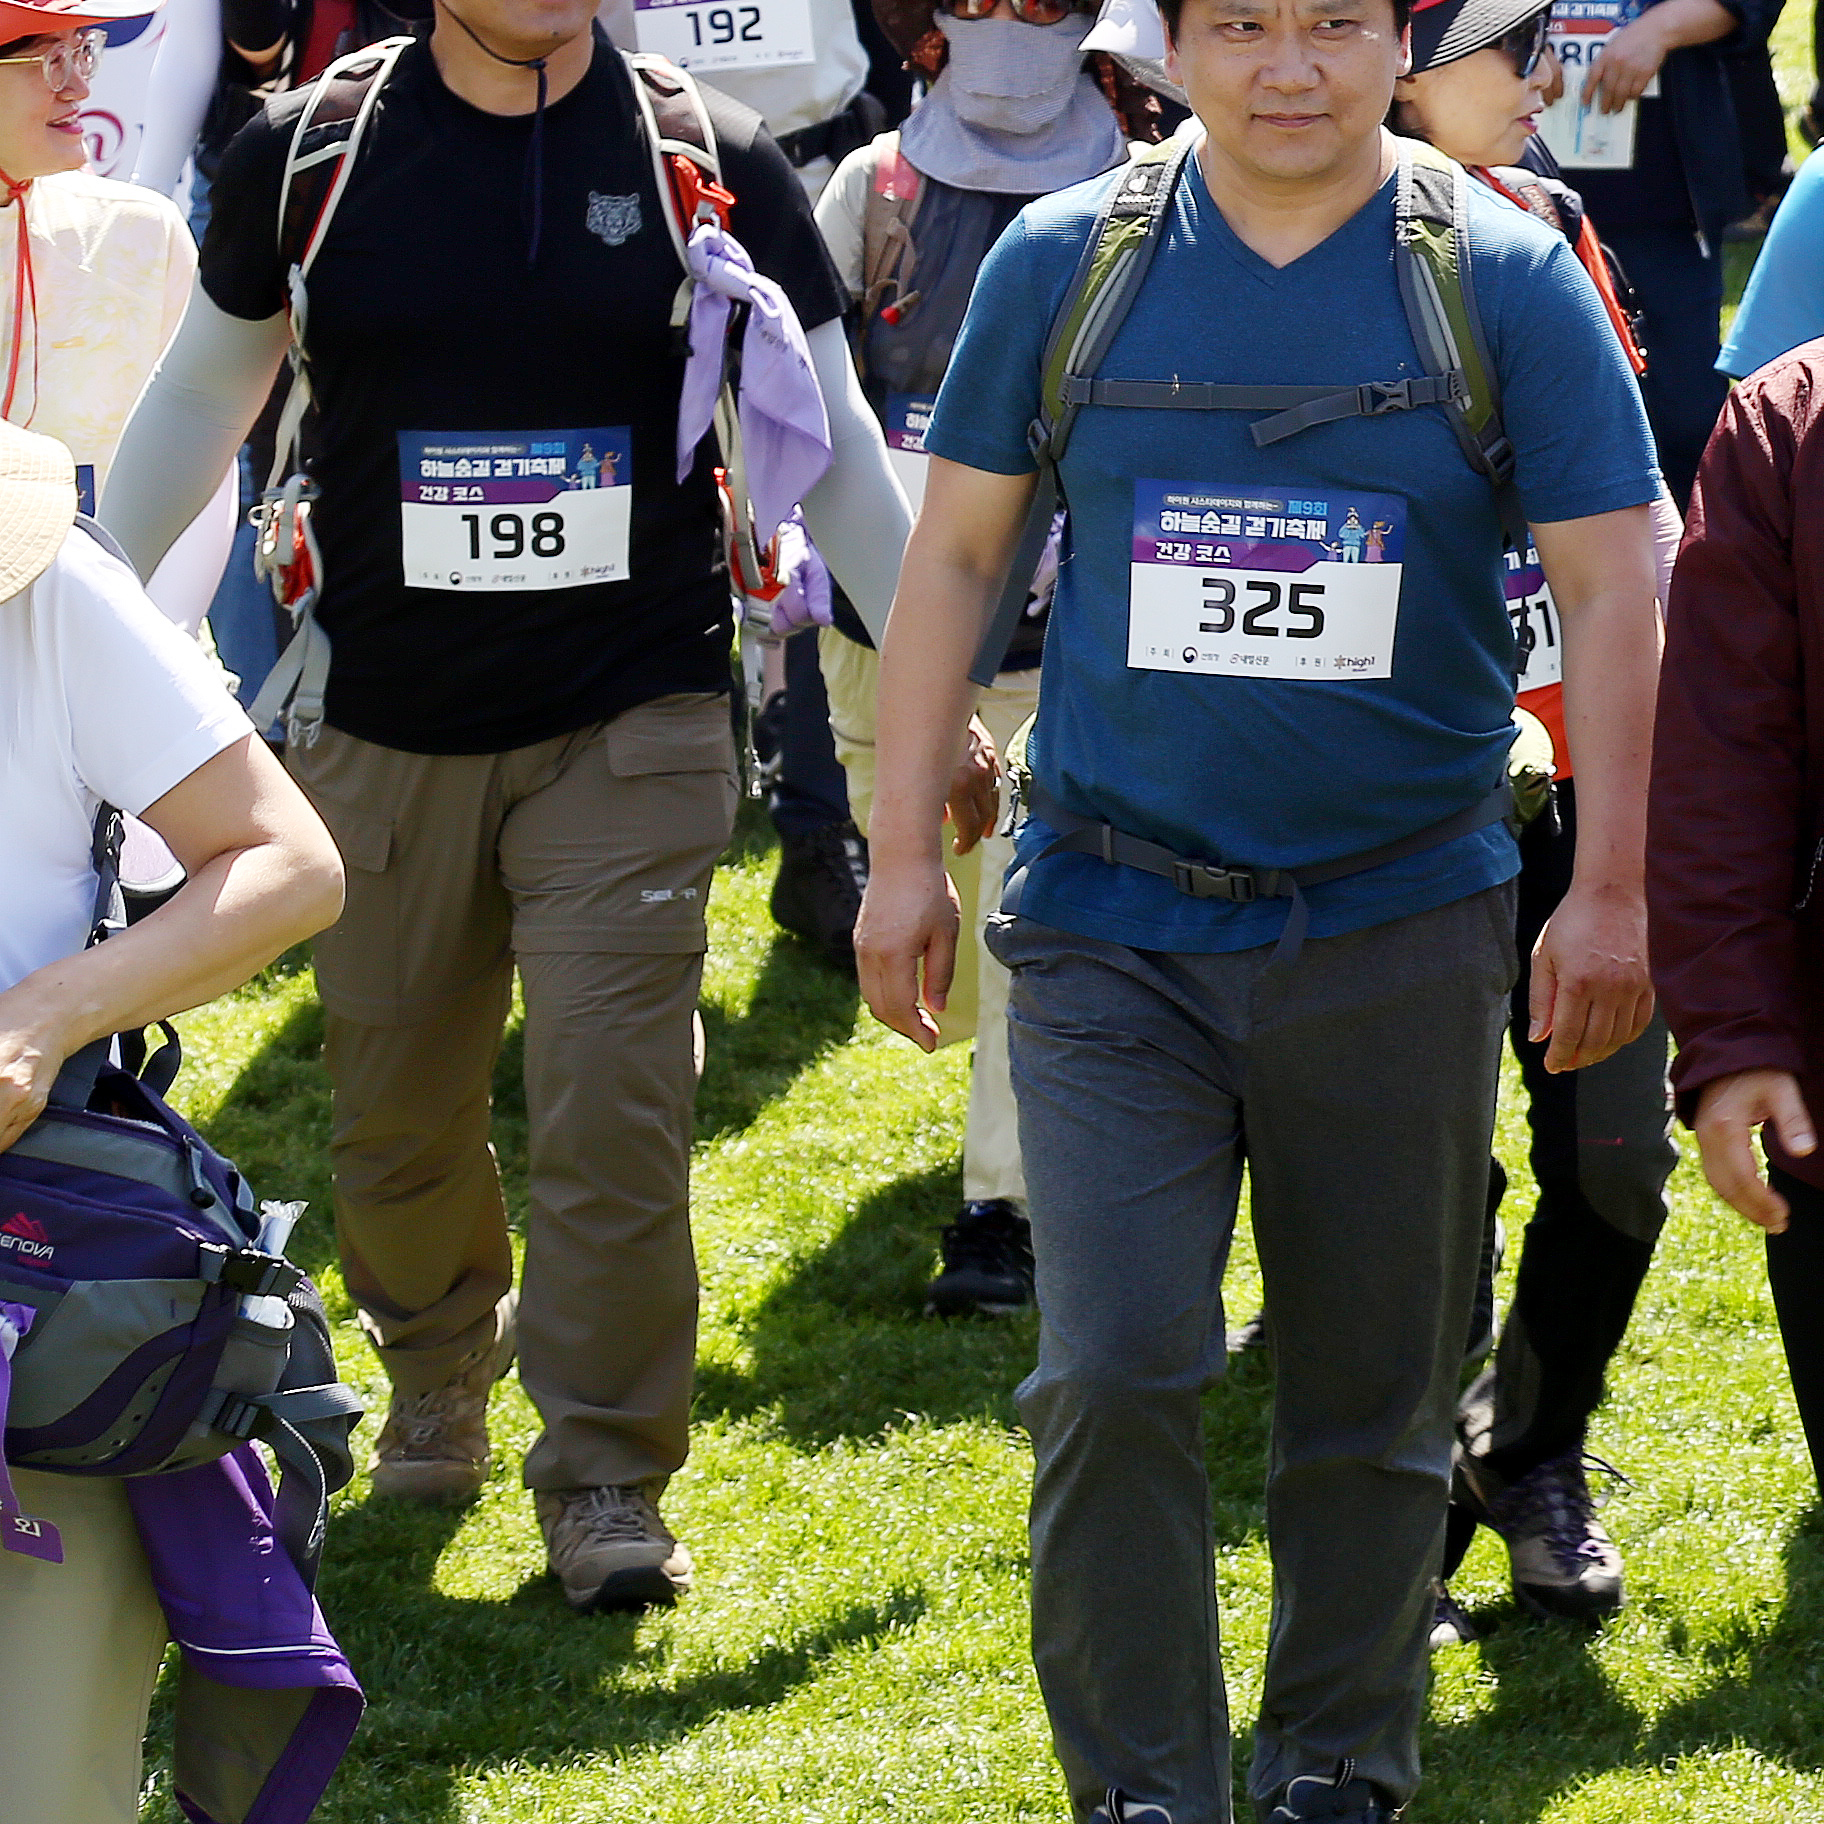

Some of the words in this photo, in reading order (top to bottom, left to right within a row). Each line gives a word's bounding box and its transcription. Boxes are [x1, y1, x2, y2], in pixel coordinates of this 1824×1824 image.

[686, 6, 762, 46] 192
[420, 457, 491, 478] 하늘숲길
[419, 484, 449, 501] 건강
[452, 485, 484, 501] 코스
[461, 512, 565, 560] 198
[1161, 510, 1242, 537] 하늘숲길
[1245, 514, 1327, 541] 걷기축제
[1155, 541, 1191, 561] 건강
[1195, 545, 1231, 563] 코스
[1199, 578, 1325, 639] 325
